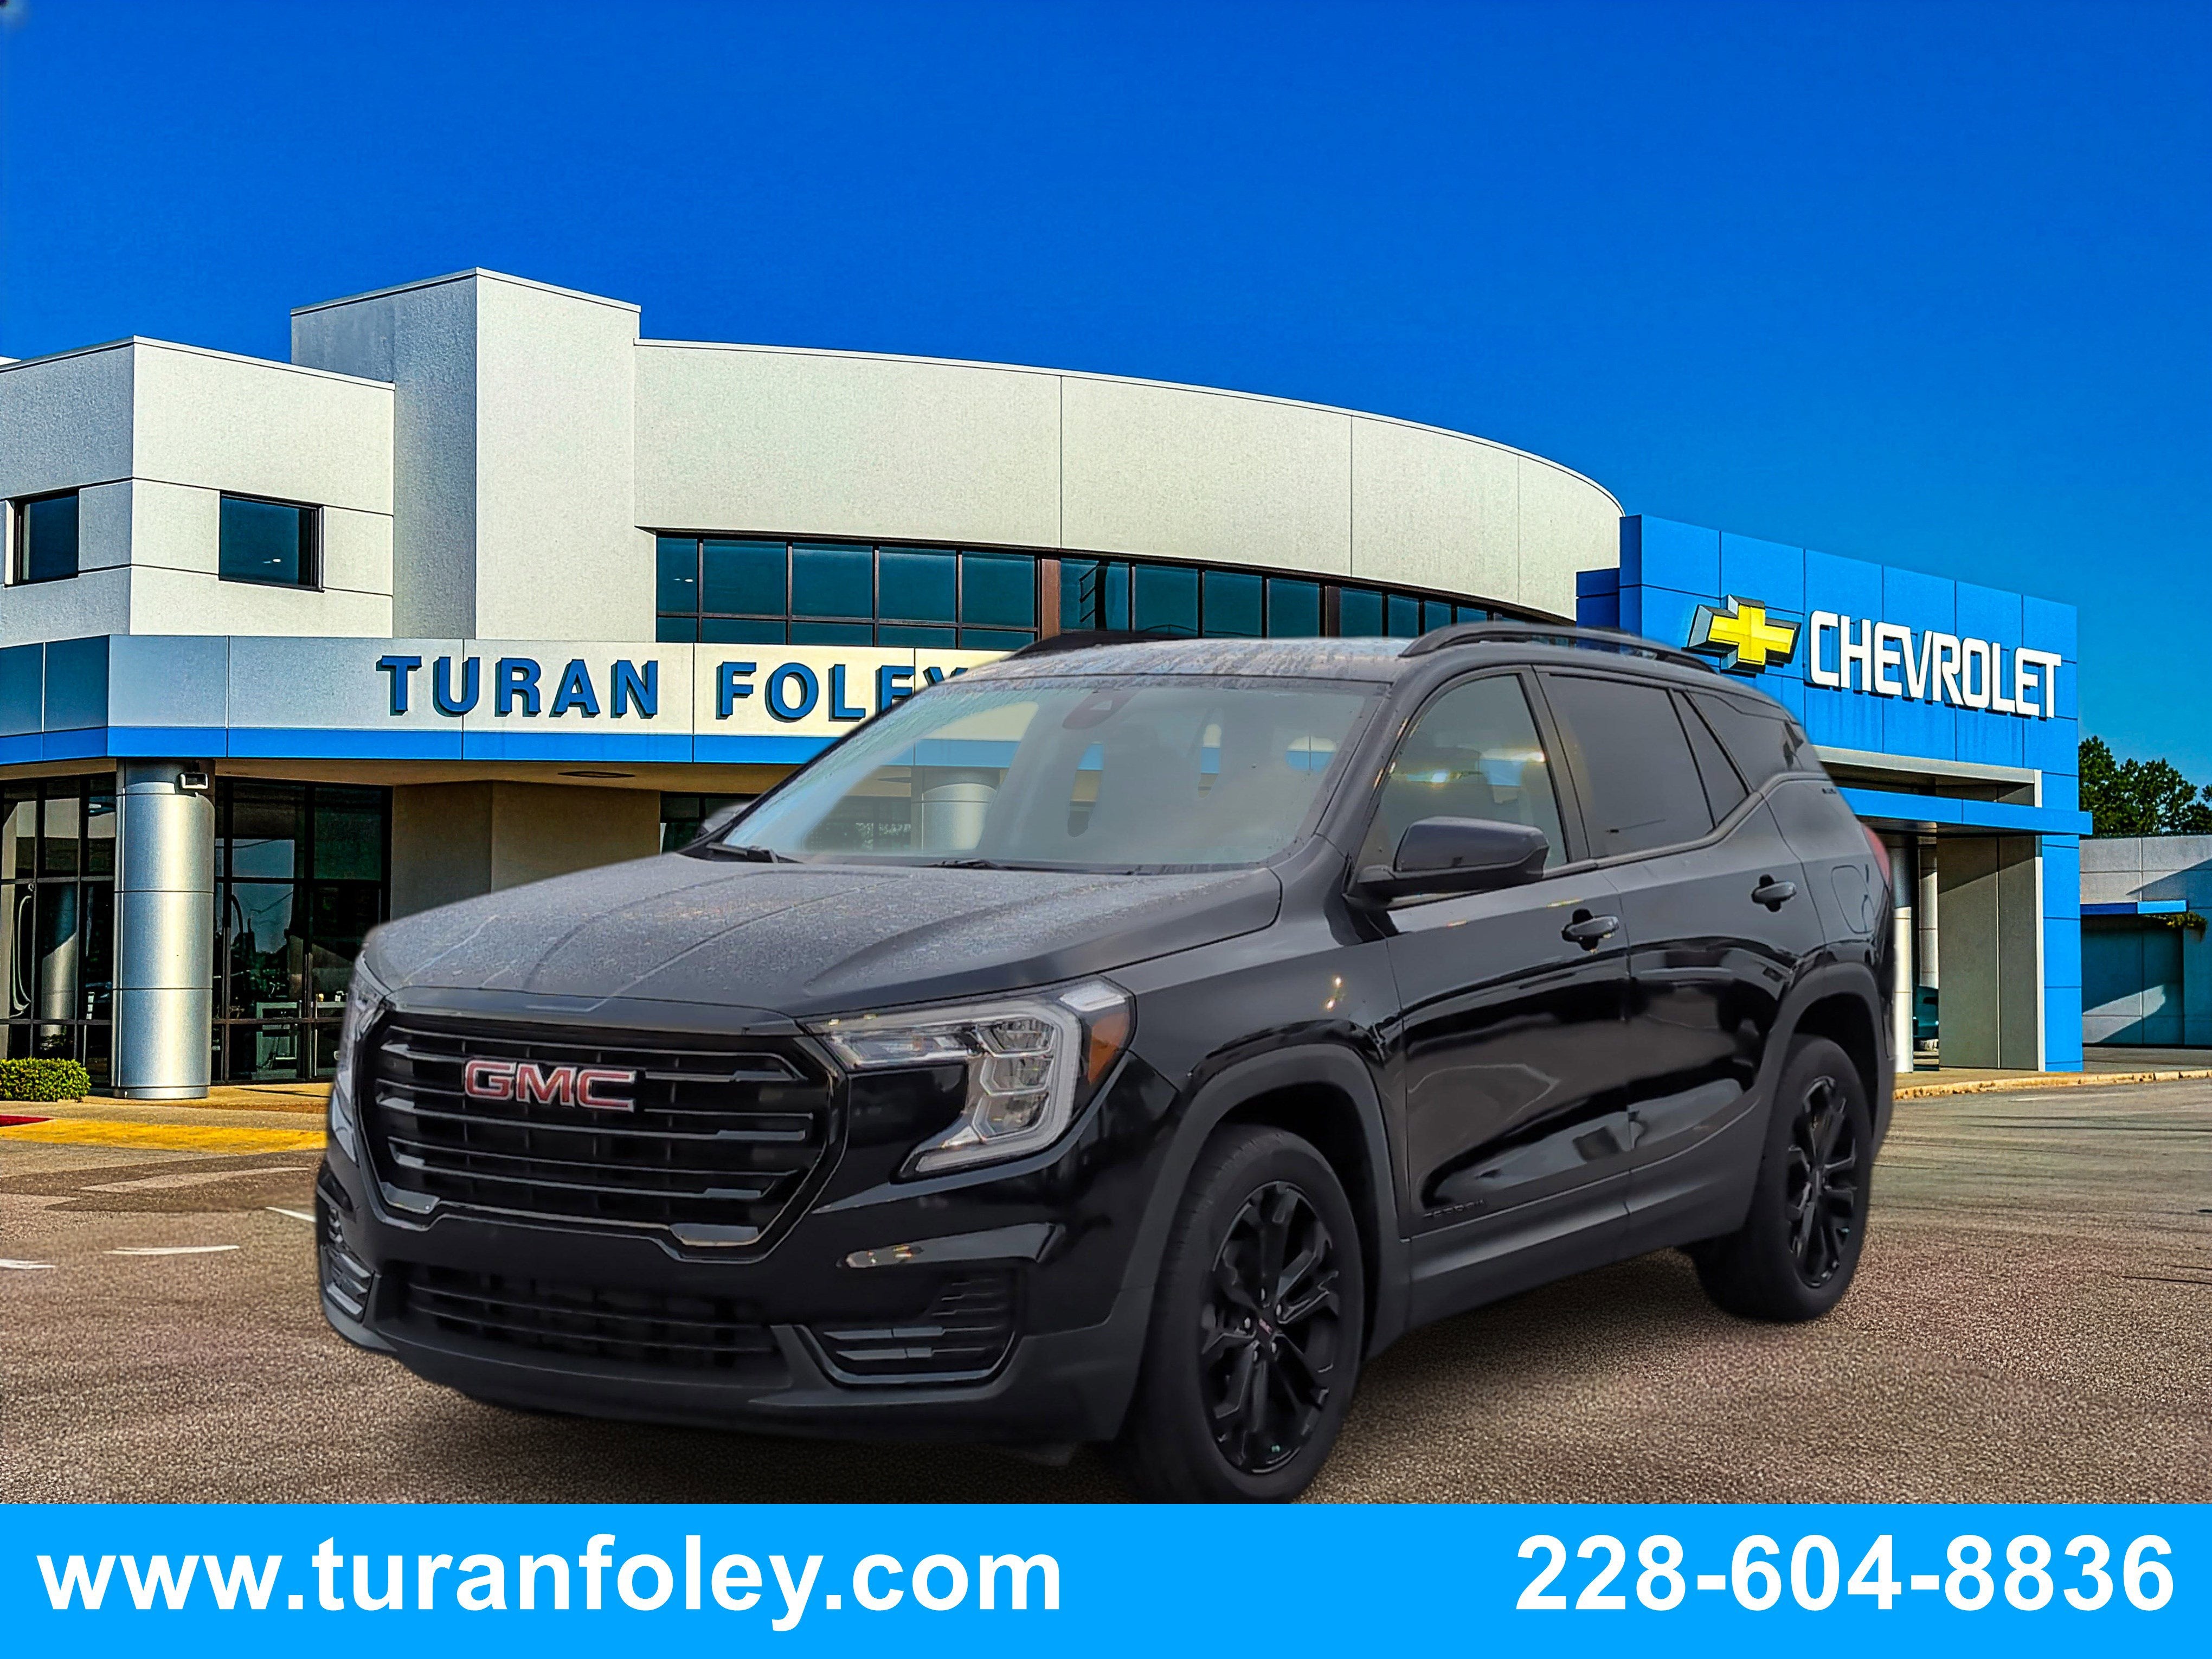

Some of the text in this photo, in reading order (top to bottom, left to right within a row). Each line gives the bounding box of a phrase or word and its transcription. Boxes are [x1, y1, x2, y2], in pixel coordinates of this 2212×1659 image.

[376, 655, 658, 718] TURAN
[1810, 610, 2061, 718] CHEVROLET
[464, 1058, 636, 1112] GMC
